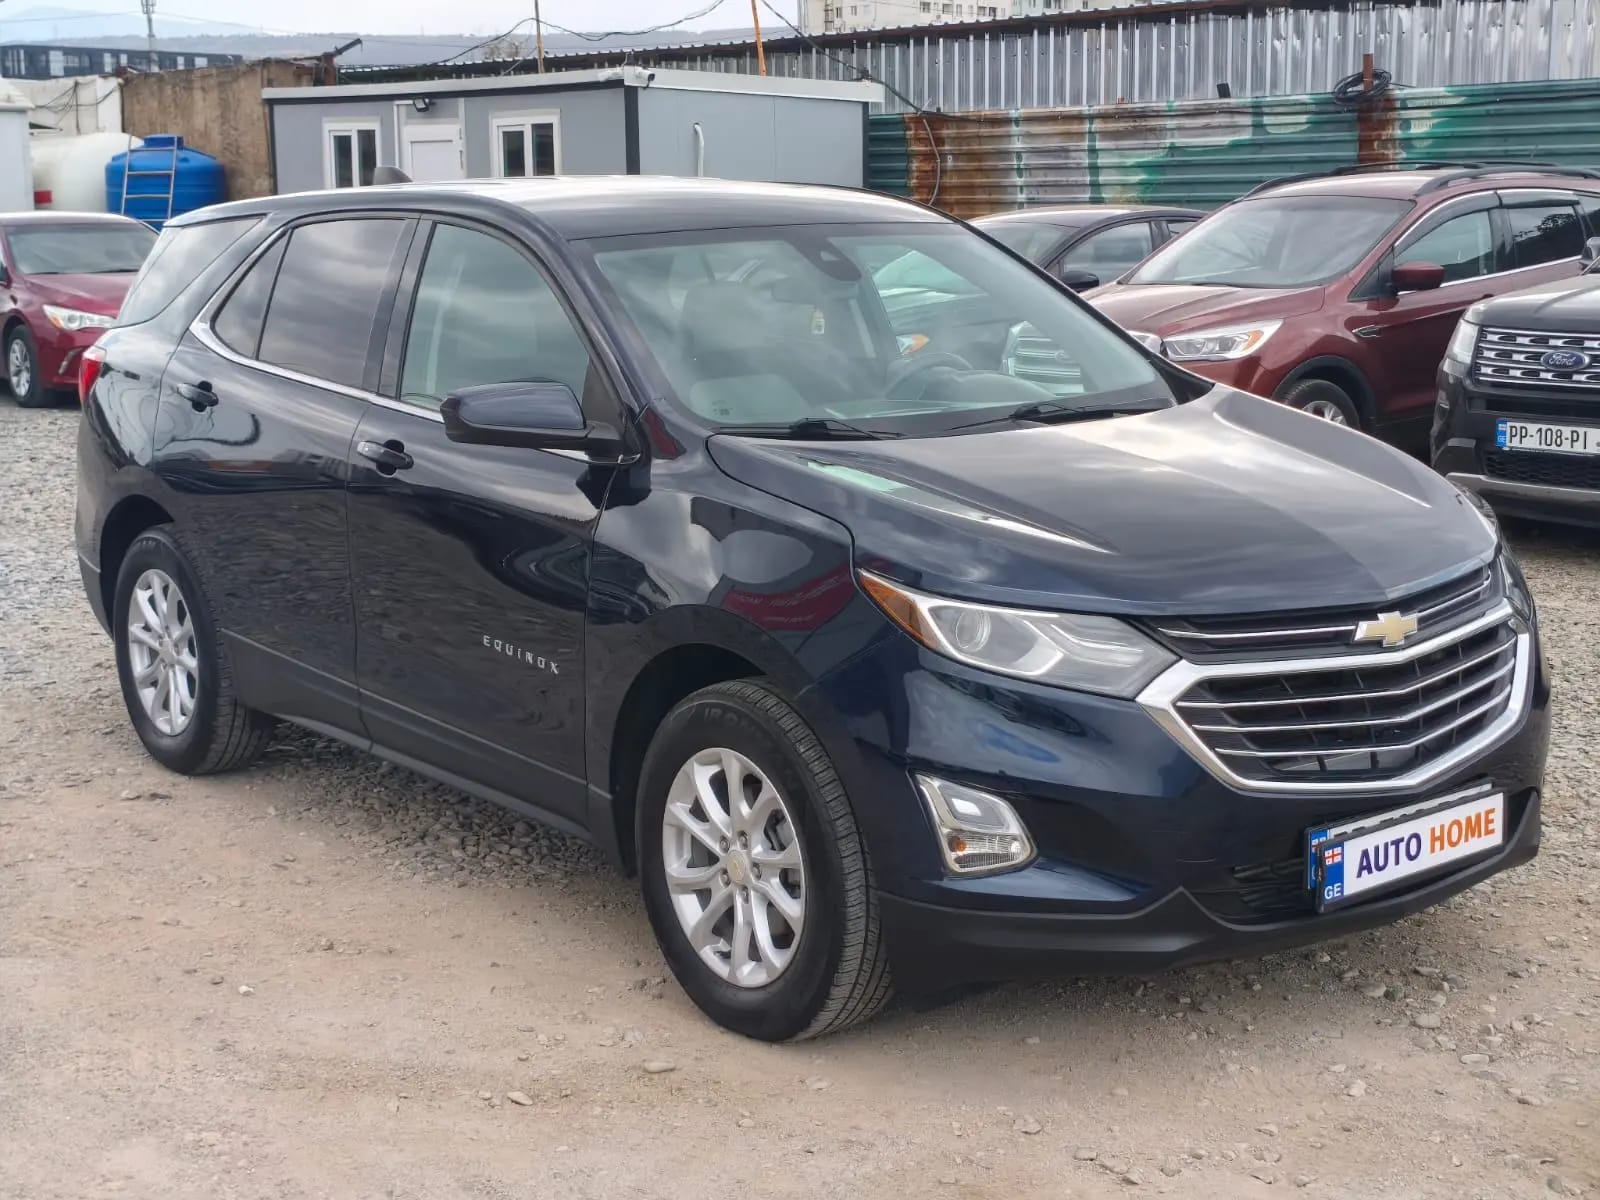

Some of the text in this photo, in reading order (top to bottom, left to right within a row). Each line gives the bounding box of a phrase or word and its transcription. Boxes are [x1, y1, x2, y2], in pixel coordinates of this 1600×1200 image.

[1548, 353, 1577, 366] Ford
[1509, 425, 1587, 450] PP-108-PI
[483, 634, 559, 674] EQUINOX
[1356, 832, 1422, 879] AUTO
[1429, 807, 1496, 855] HOME
[1324, 882, 1342, 900] GE
